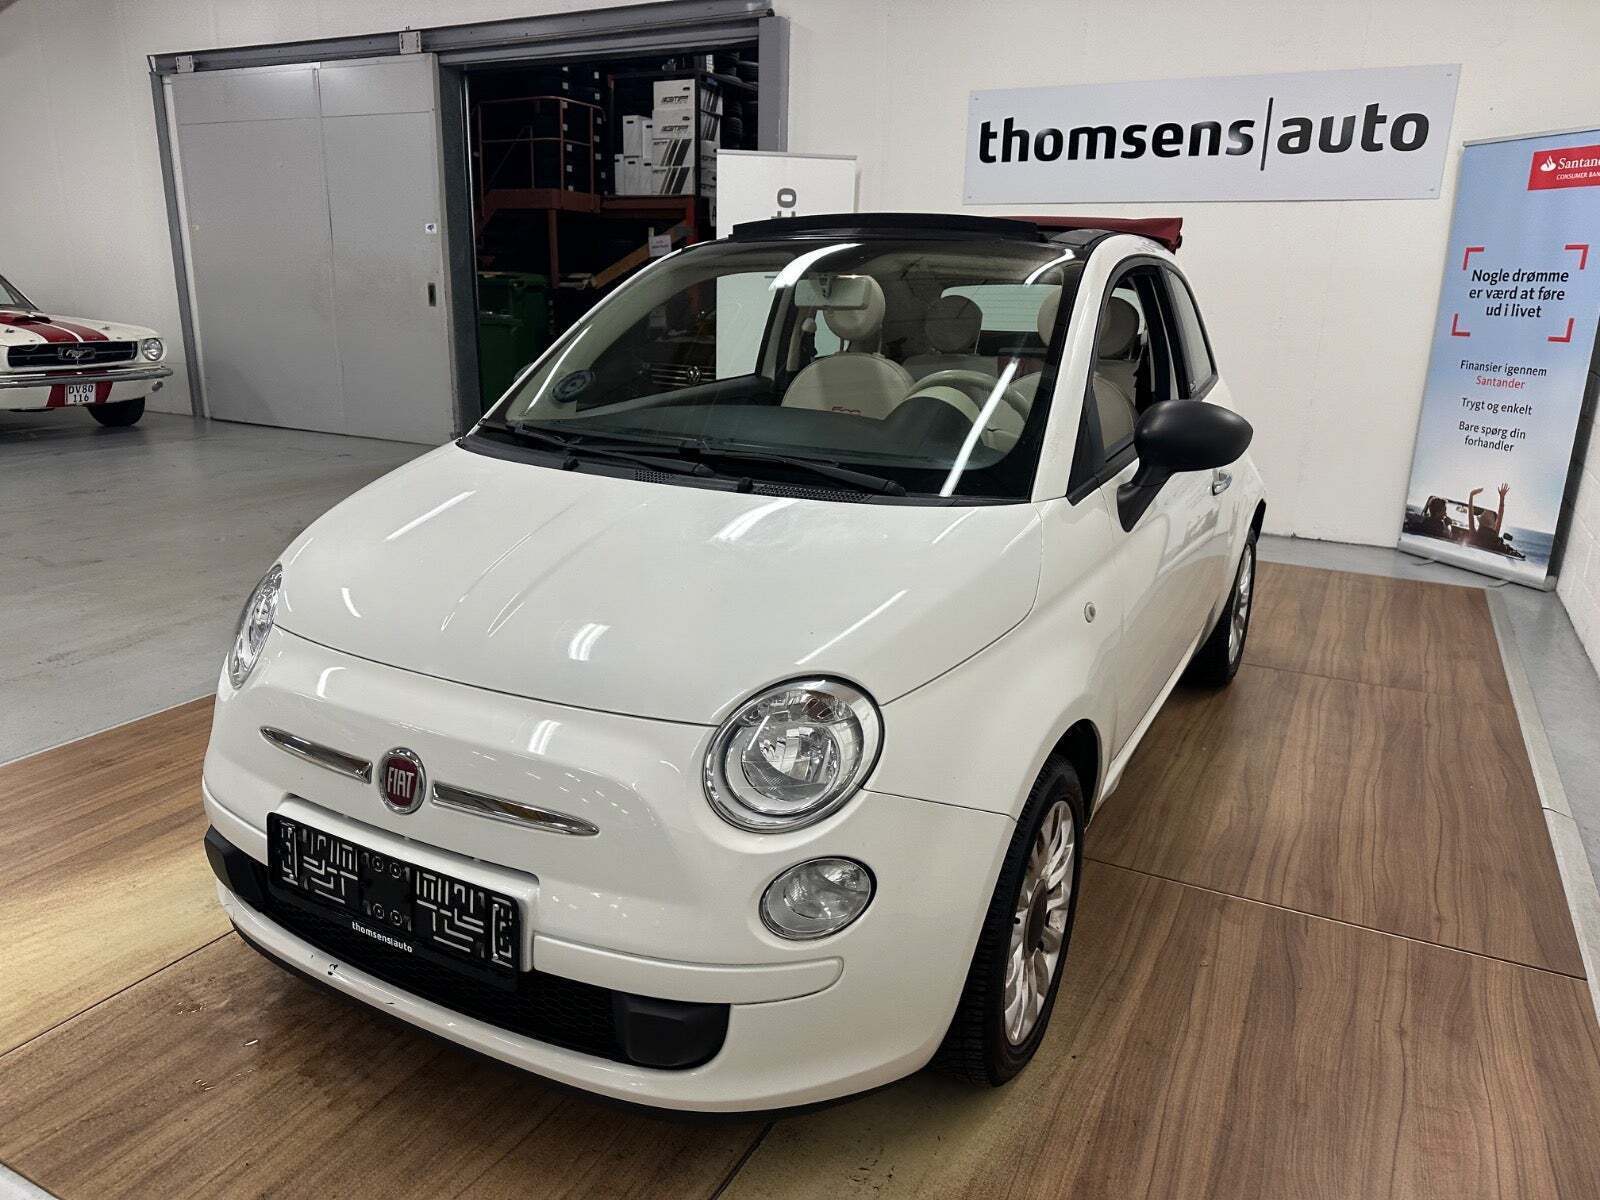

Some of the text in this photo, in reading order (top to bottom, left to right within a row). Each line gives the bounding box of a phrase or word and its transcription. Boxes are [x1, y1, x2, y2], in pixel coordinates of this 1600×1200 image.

[1556, 172, 1588, 180] CONSUMER
[1471, 268, 1570, 286] Nogle drømme
[1468, 286, 1565, 301] er værd at føre
[1485, 303, 1542, 318] ud i livet
[1460, 359, 1547, 377] Finansier igennem
[1475, 375, 1526, 389] Santander
[73, 394, 90, 403] 116
[1462, 397, 1533, 415] Trygt og enkelt
[1459, 421, 1527, 440] Bare spørg din
[1464, 435, 1515, 453] forhandler
[387, 766, 415, 799] FIAT
